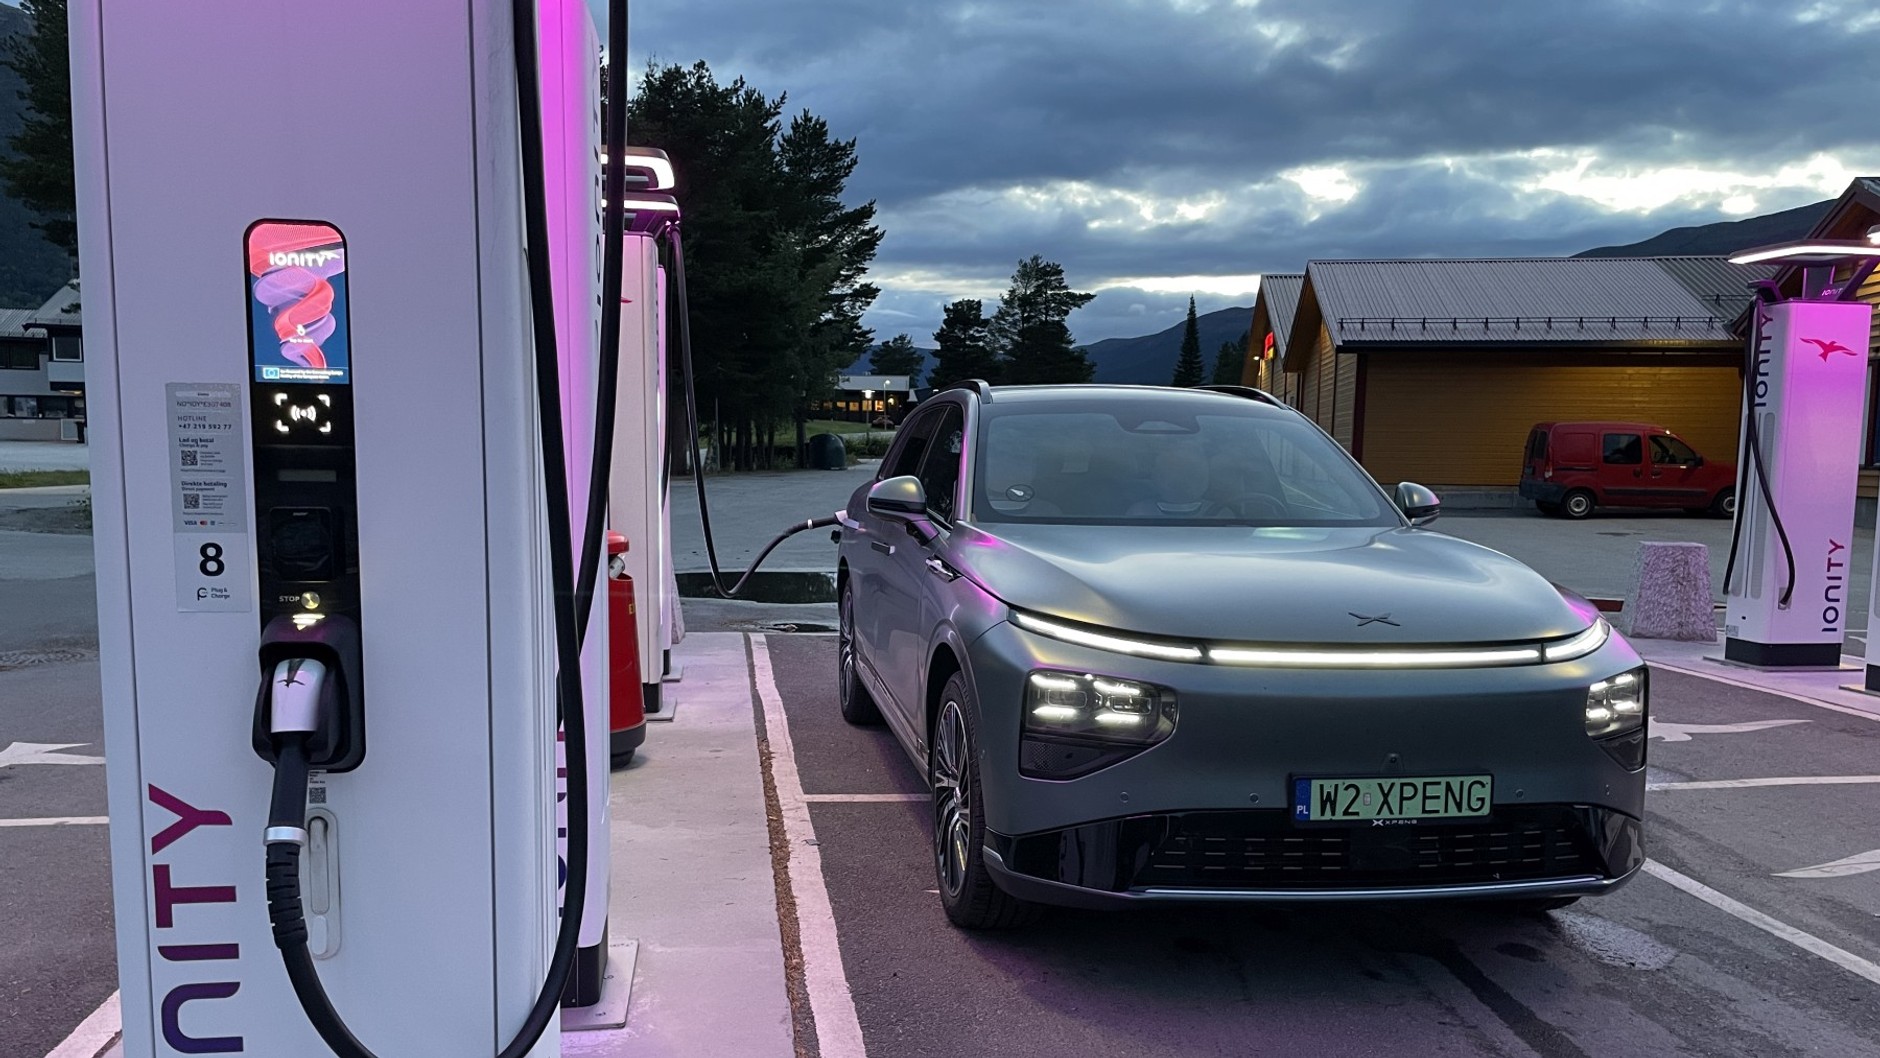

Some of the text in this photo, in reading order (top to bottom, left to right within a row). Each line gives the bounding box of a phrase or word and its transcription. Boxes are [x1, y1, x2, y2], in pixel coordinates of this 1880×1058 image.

[269, 252, 326, 267] IONITY
[1821, 287, 1844, 296] IONIT
[199, 542, 225, 577] 8
[1821, 539, 1845, 632] IONITY
[1296, 780, 1486, 817] PL W2 XPENG
